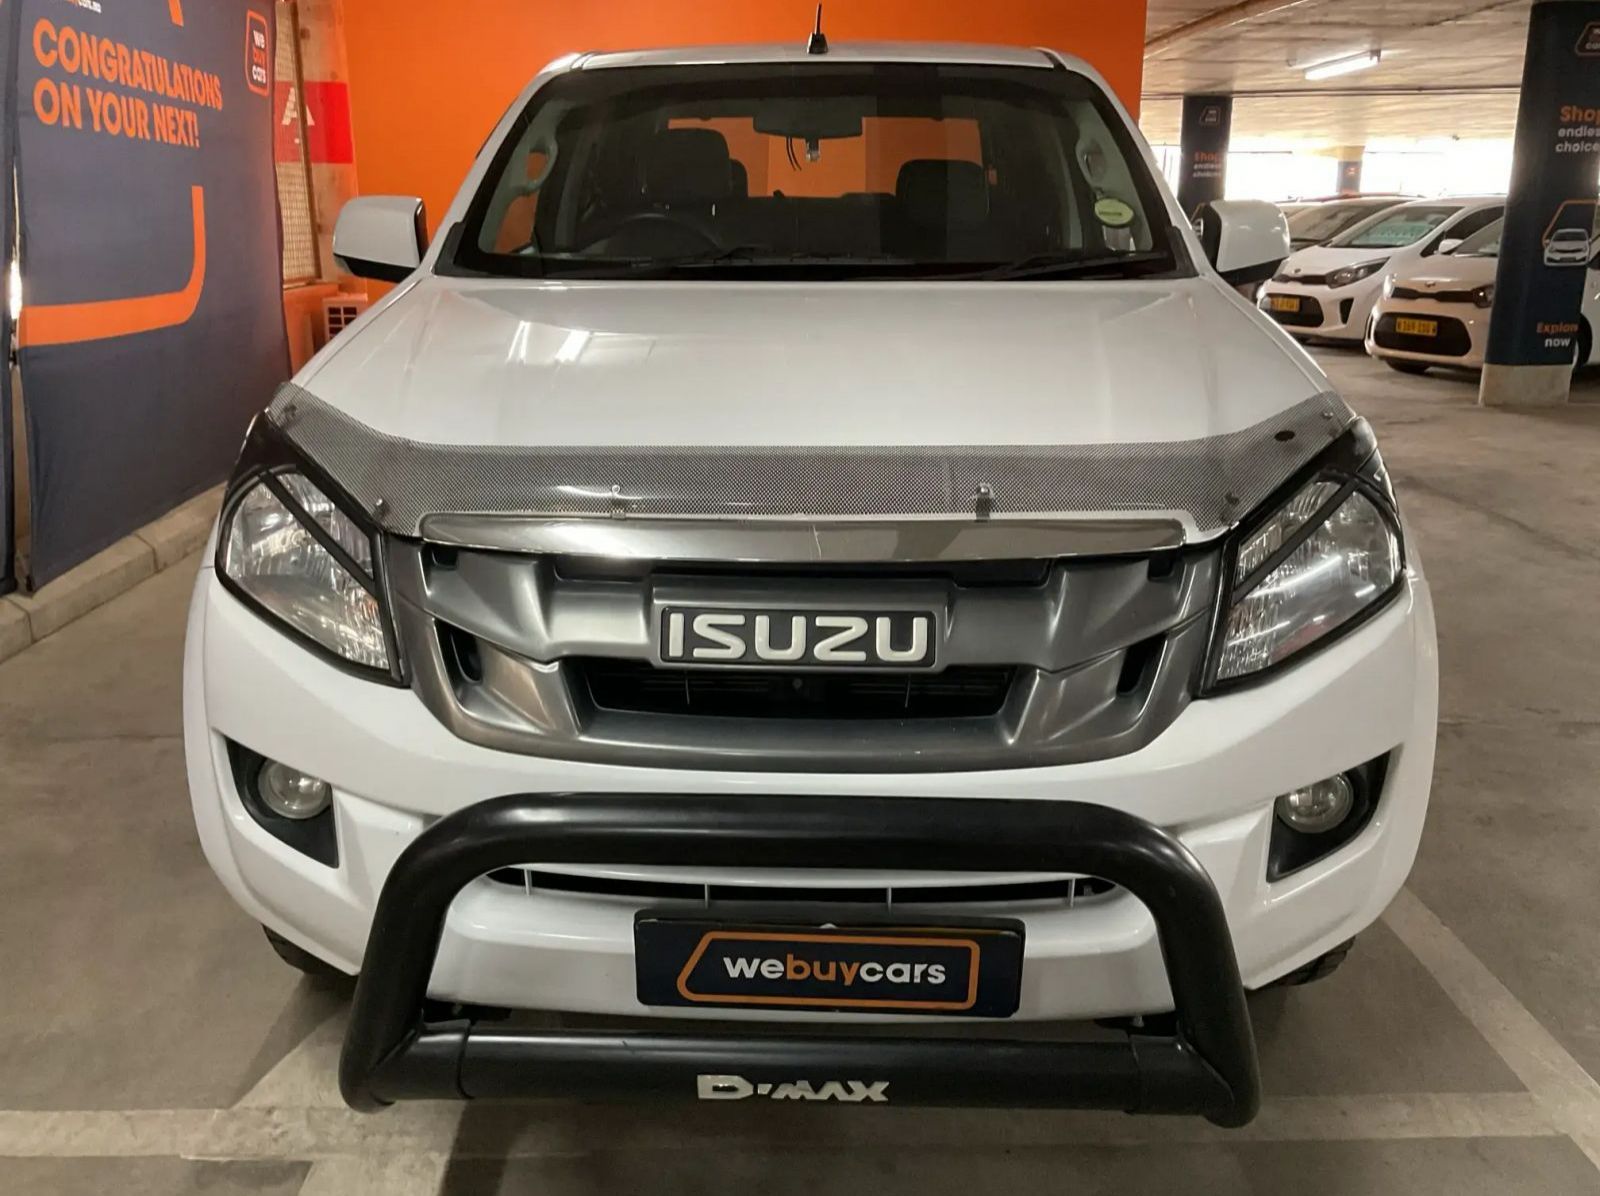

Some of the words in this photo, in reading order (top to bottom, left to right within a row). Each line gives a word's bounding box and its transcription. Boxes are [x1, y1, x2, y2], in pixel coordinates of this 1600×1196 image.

[33, 18, 223, 111] CONGRATULATIONS
[33, 77, 82, 130] ON
[86, 87, 150, 141] YOUR
[152, 102, 200, 148] NEXT!
[1544, 337, 1571, 347] now
[668, 612, 928, 662] ISUZU
[723, 953, 946, 986] webuycars
[697, 1074, 890, 1102] D-MAX
